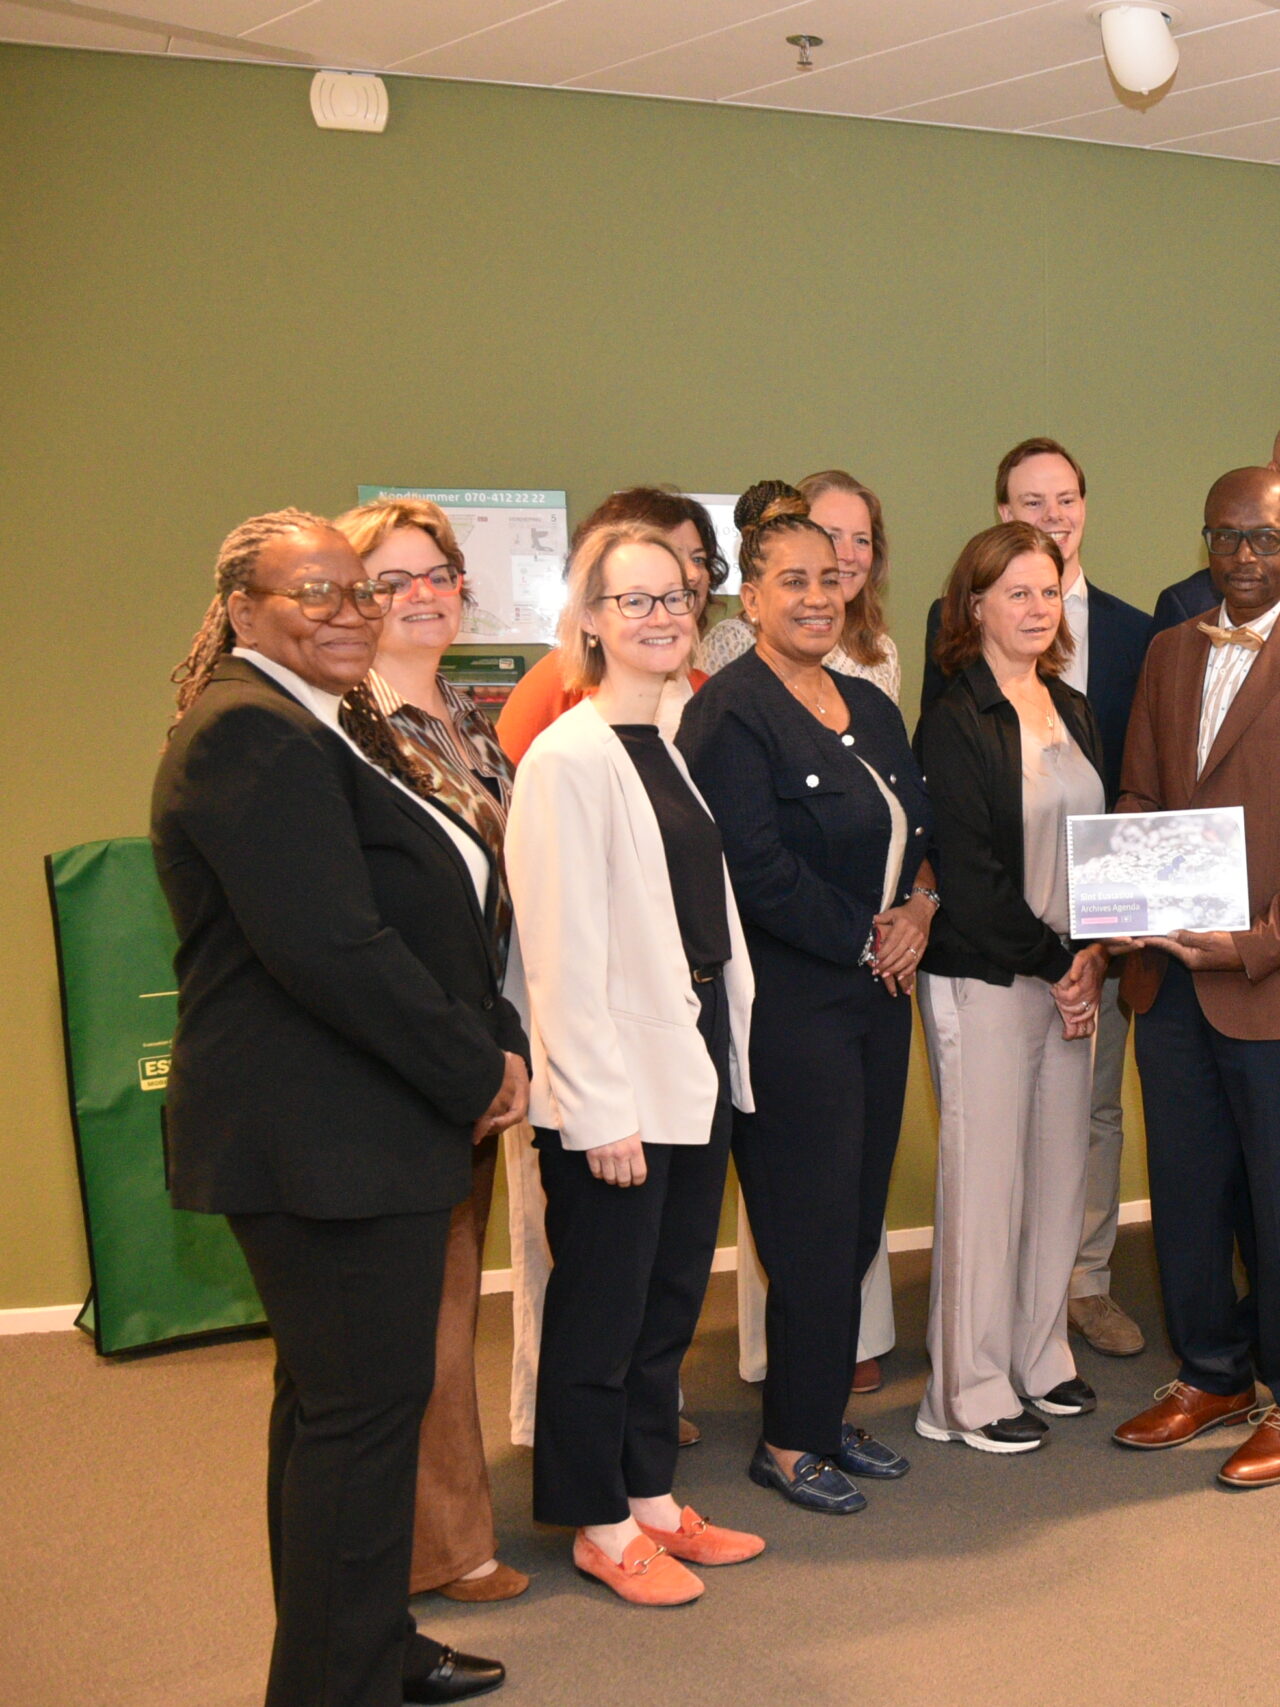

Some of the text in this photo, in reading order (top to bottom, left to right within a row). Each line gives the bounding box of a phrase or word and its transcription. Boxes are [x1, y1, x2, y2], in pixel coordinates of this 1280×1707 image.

[464, 492, 512, 504] 070-412
[515, 493, 529, 504] 22
[532, 493, 546, 504] 22
[1081, 903, 1141, 913] Archives Agenda
[145, 1059, 171, 1077] ES
